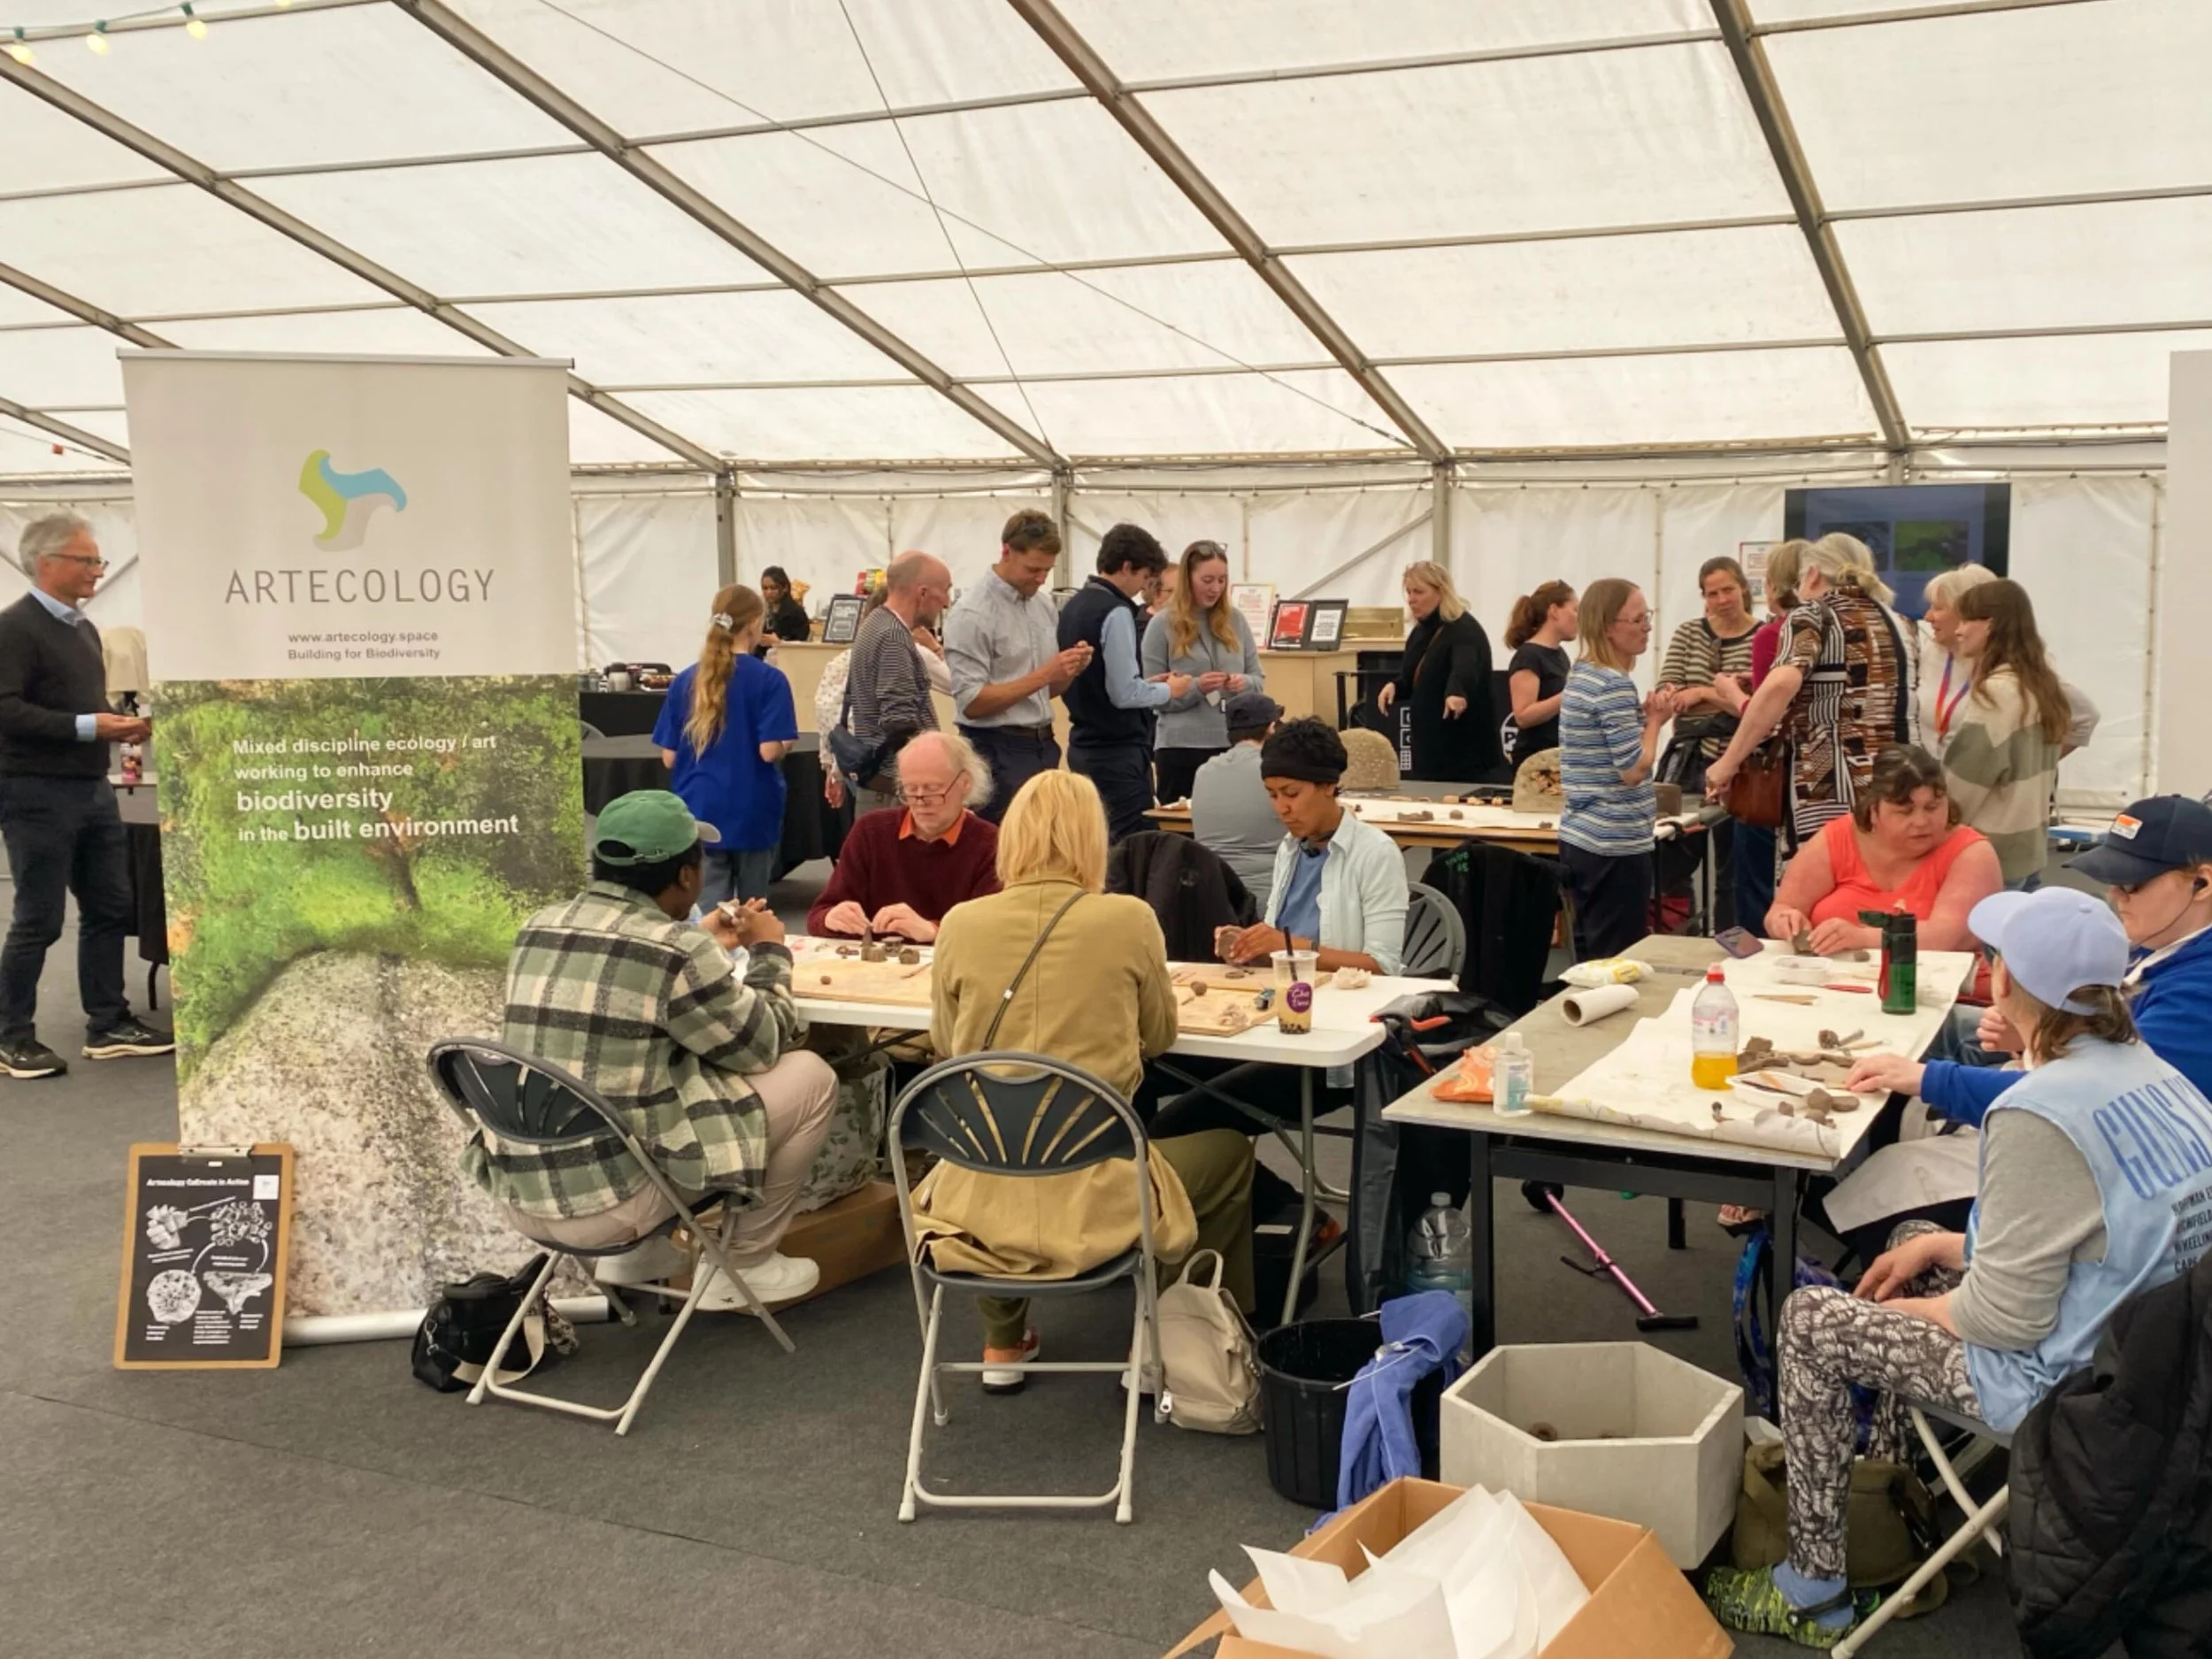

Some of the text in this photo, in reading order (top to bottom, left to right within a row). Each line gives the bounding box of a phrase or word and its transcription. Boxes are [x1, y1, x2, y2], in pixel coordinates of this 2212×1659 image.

[225, 569, 494, 603] ARTECOLOGY
[288, 631, 439, 643] www.artecology.space
[288, 648, 441, 661] Building for Biodiversity
[233, 739, 286, 754] Mixed
[292, 737, 380, 754] discipline
[386, 736, 457, 752] ecology
[472, 735, 496, 749] art
[234, 762, 413, 780] working to enhance
[236, 787, 394, 812] biodiversity
[238, 815, 519, 841] in the built environment
[2093, 1084, 2212, 1200] GUNS
